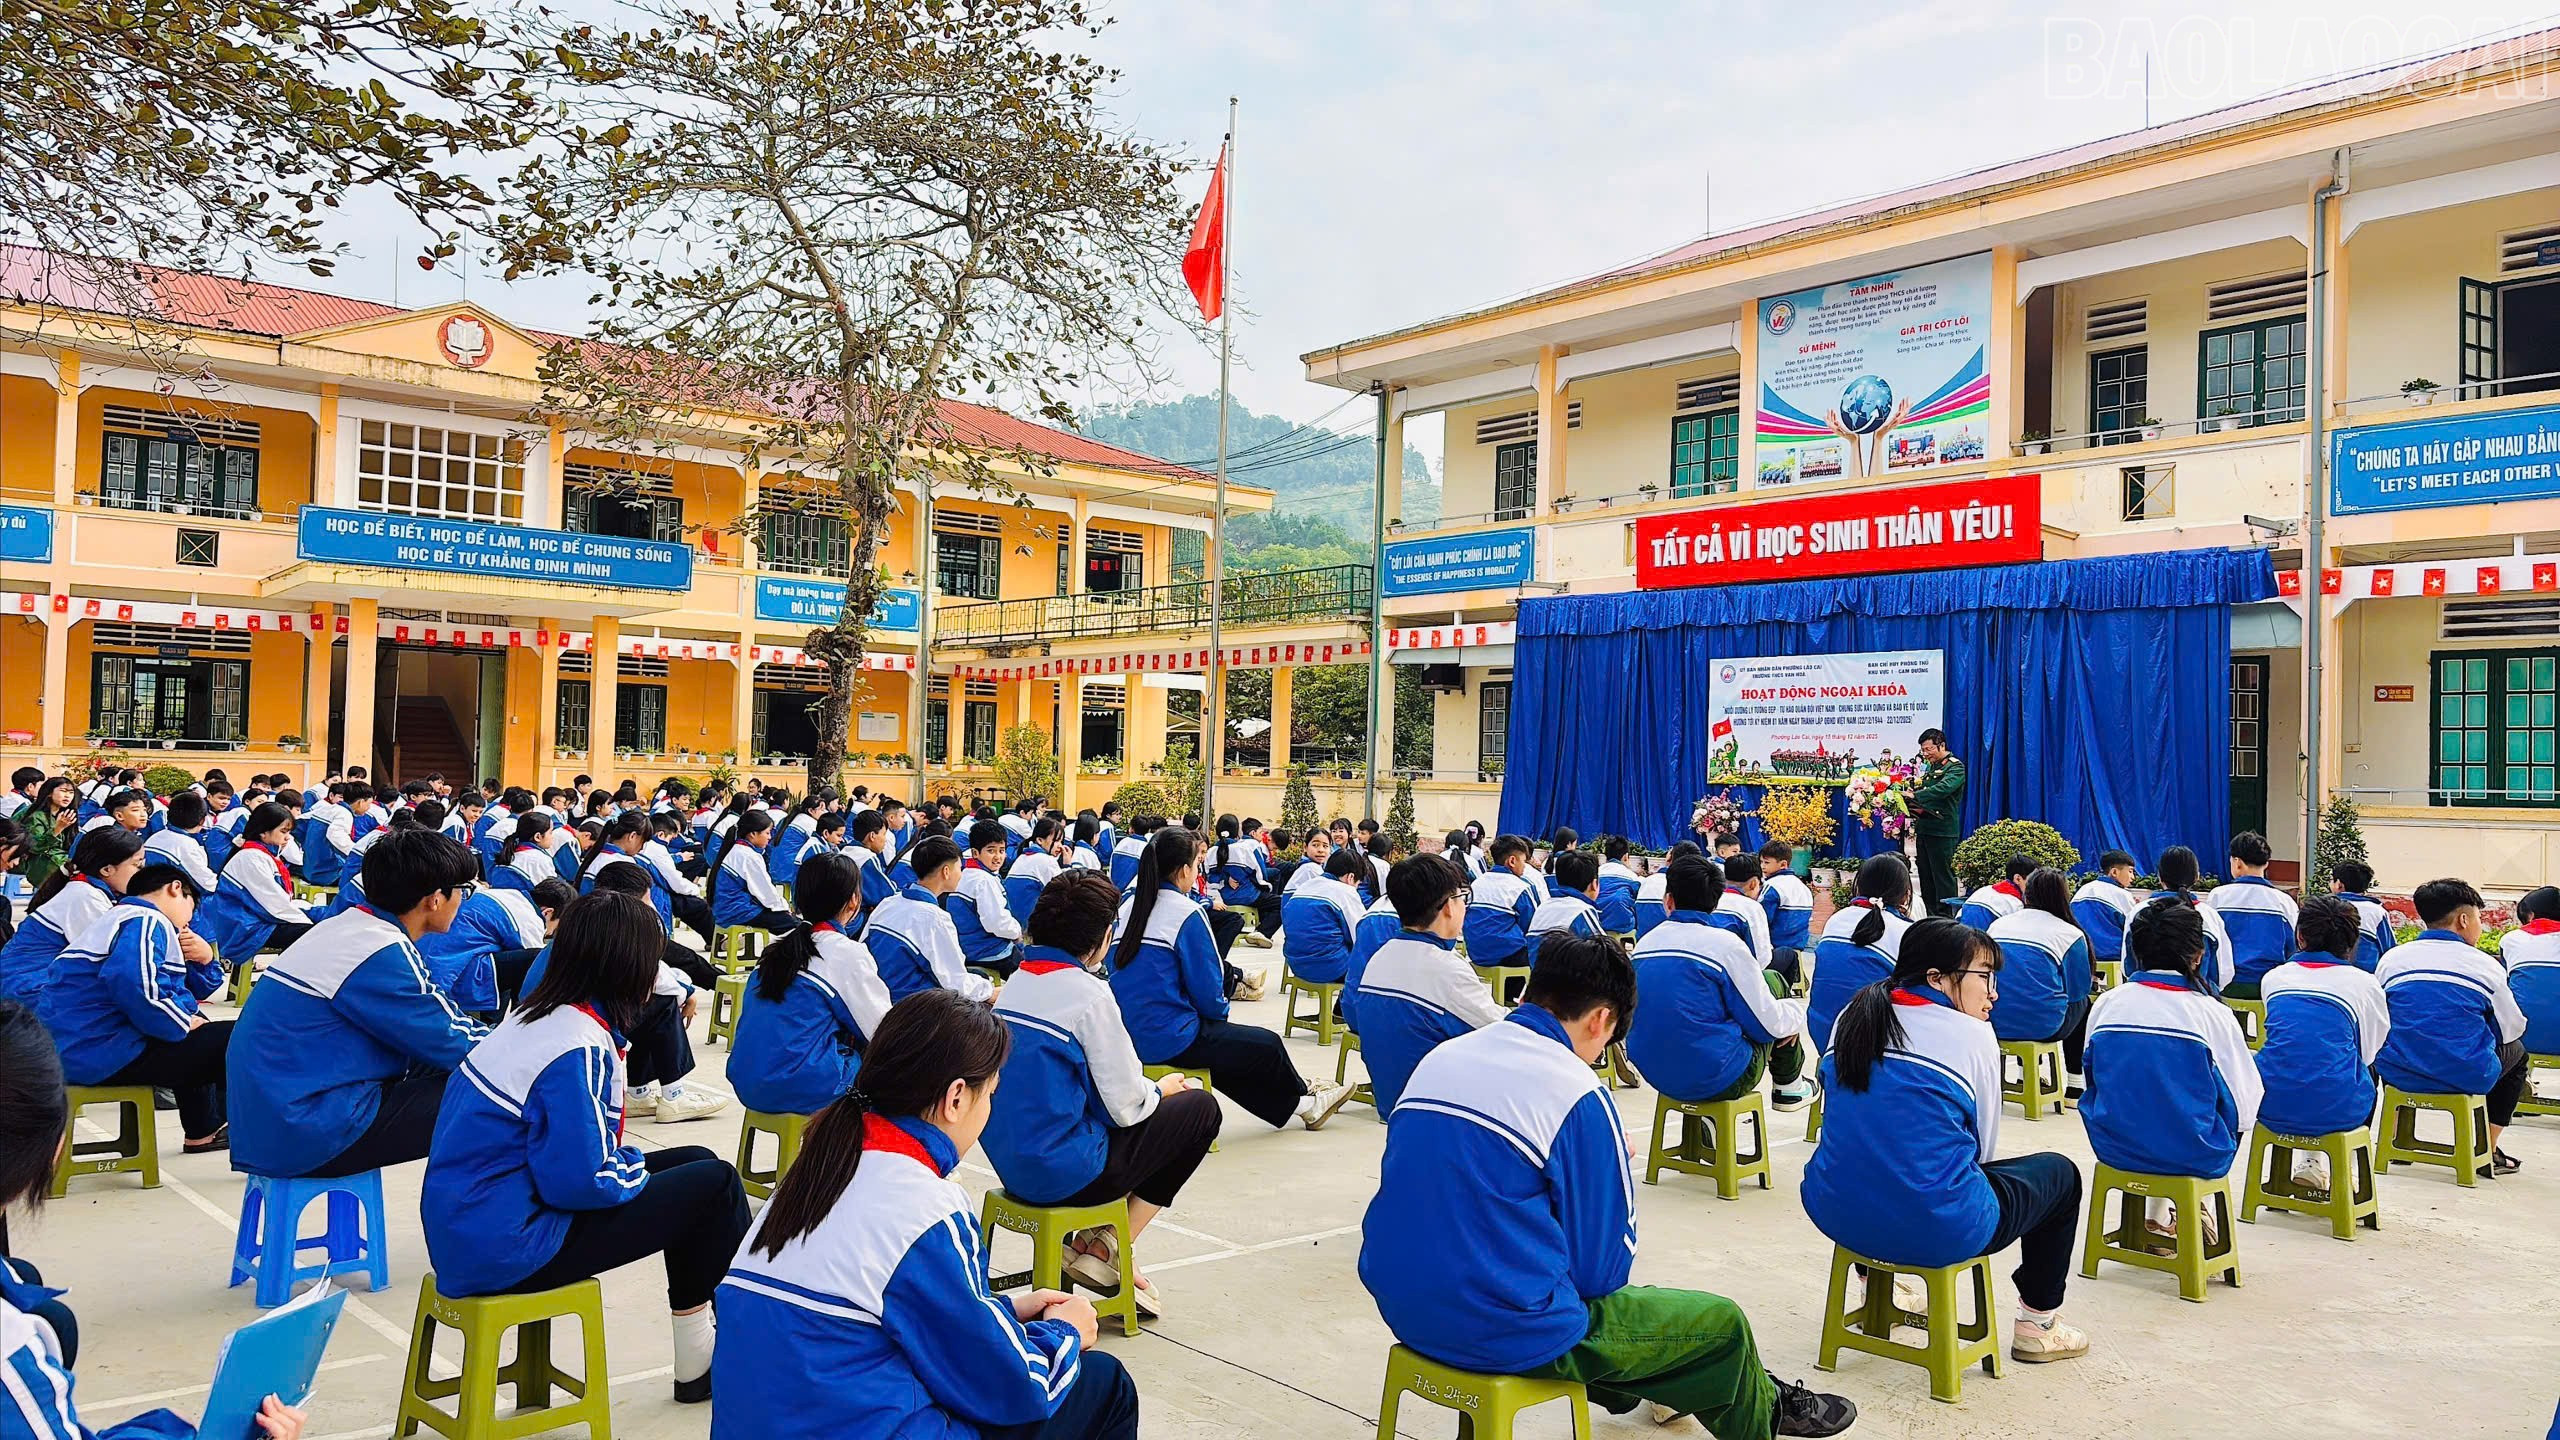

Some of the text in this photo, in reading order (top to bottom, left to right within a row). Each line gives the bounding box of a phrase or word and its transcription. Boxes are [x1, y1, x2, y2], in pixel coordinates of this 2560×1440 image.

[1871, 281, 1894, 292] NHÌN
[1890, 290, 1905, 298] THCS
[2404, 446, 2420, 467] TA
[2423, 441, 2450, 465] HÃY
[2453, 437, 2481, 466] GẶP
[2485, 434, 2524, 459] NHAU
[2422, 473, 2460, 490] MEET
[2462, 468, 2500, 486] EACH
[2504, 464, 2551, 482] OTHER
[326, 517, 672, 564] HỌC ĐỂ BIẾT, HỌC ĐỂ LÀM, HỌC ĐỂ CHUNG SỐNG
[1651, 527, 1690, 568] TẤT
[1694, 523, 1725, 564] CẢ
[1728, 522, 1750, 561] VÌ
[1757, 525, 1804, 564] HỌC
[1810, 518, 1868, 554] SINH
[1875, 505, 1942, 548] THÂN
[398, 546, 611, 578] HỌC ĐỂ TỰ KHẲNG ĐỊNH MÌNH
[1484, 544, 1492, 560] LÀ
[1434, 572, 1441, 580] OF
[1442, 568, 1476, 580] HAPPINESS
[1477, 567, 1484, 576] IS
[767, 584, 781, 596] Dạy
[783, 586, 794, 596] mà
[820, 588, 834, 600] bao
[792, 600, 803, 614] ĐÓ
[805, 601, 815, 615] LÀ
[818, 603, 836, 616] TÌNH
[1742, 682, 1907, 702] HOẠT ĐỘNG NGOẠI KHÓA
[1414, 1374, 1479, 1408] 7A2 24-25
